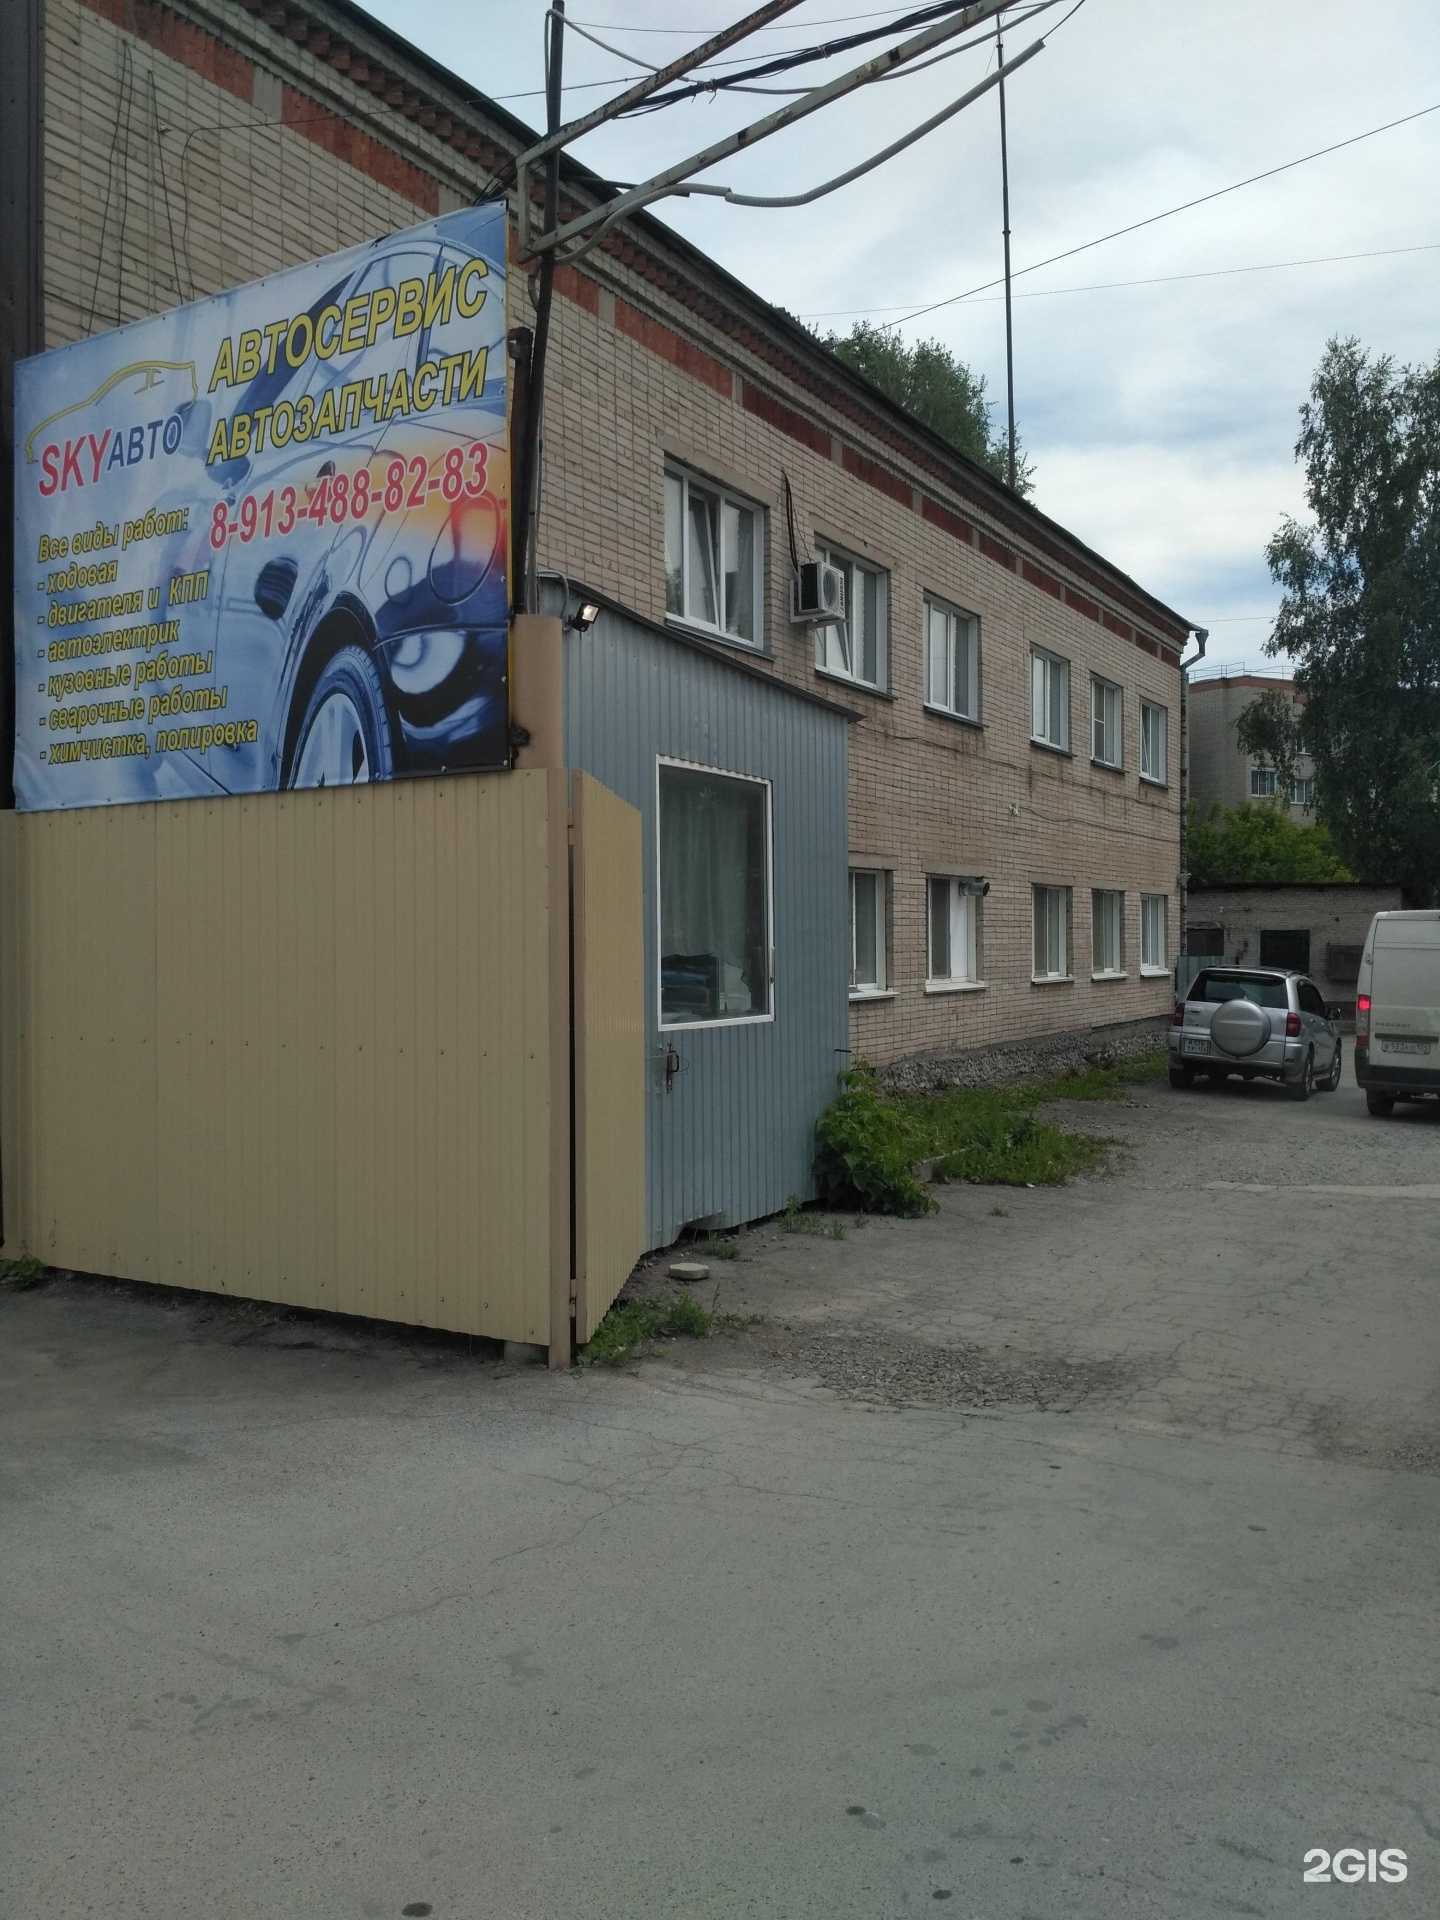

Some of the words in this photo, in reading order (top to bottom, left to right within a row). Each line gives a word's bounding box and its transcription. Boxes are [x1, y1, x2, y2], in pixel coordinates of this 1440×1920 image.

[207, 257, 489, 393] АВТОСЕРВИС
[205, 346, 489, 466] АВТОЗАПЧАСТИ
[209, 442, 489, 549] 8-913-488-82-83
[37, 533, 69, 563] Все
[71, 520, 119, 551] виды
[121, 507, 189, 550] работ:
[47, 560, 118, 594] ходовая
[48, 588, 143, 627] двигателя
[148, 587, 159, 609] и
[168, 569, 209, 606] КПП
[48, 619, 180, 662] автоэлектрик
[48, 663, 131, 701] кузовные
[134, 650, 214, 690] работы
[48, 700, 145, 733] сварочные
[148, 685, 229, 724] работы
[48, 732, 150, 765] химчистка,
[155, 718, 259, 756] полировка
